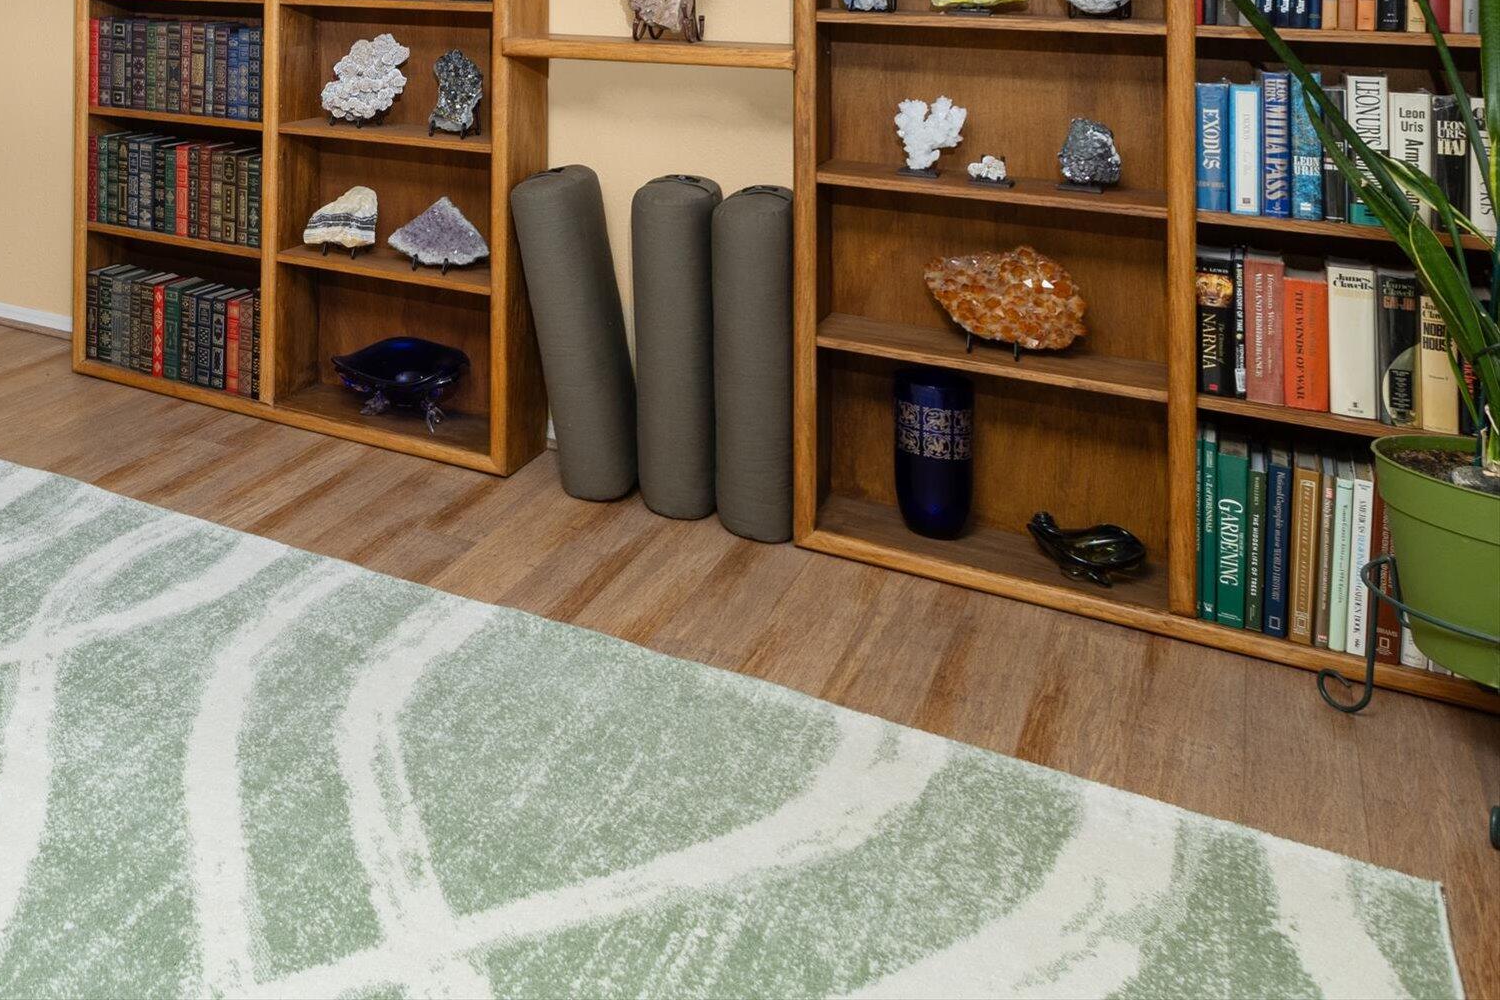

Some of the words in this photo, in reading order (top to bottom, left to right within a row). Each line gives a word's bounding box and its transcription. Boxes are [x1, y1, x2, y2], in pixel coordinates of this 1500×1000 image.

[1265, 79, 1277, 103] URIS
[1276, 79, 1288, 103] LEON
[1355, 80, 1381, 120] LEON
[1399, 107, 1426, 119] Leon
[1401, 121, 1424, 133] Uris
[1436, 120, 1467, 130] LEON
[1437, 129, 1467, 139] URIS
[1202, 108, 1221, 169] EXODUS
[1293, 155, 1321, 166] LEON
[1293, 165, 1321, 176] URIS
[1265, 157, 1288, 200] PASS
[1336, 273, 1371, 283] James
[1236, 310, 1243, 318] OF
[1295, 291, 1304, 314] THE
[1202, 312, 1217, 369] NARNIA
[1295, 318, 1305, 354] WINDS
[1296, 357, 1305, 372] OF
[1296, 374, 1306, 400] WAR
[1275, 471, 1286, 496] National
[1218, 498, 1244, 586] GARDENING
[1251, 567, 1258, 576] OF
[1271, 572, 1281, 602] HISTORY
